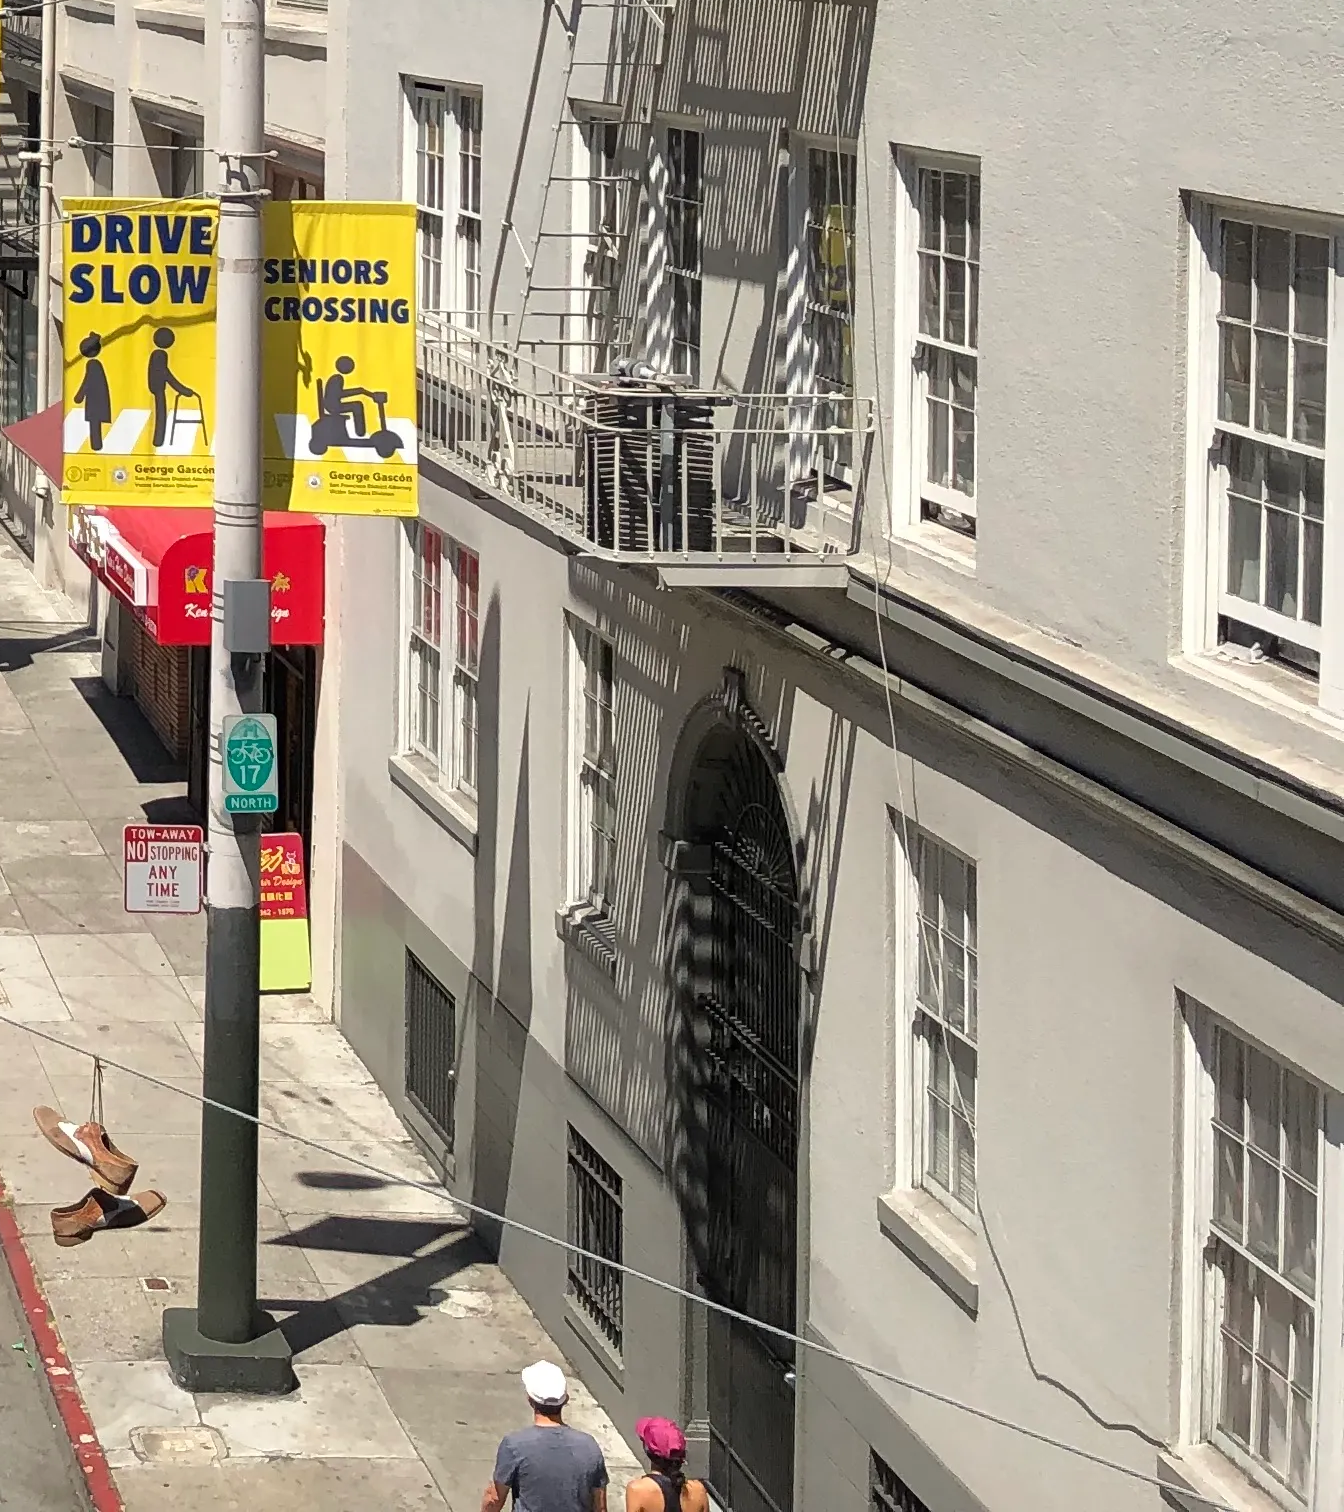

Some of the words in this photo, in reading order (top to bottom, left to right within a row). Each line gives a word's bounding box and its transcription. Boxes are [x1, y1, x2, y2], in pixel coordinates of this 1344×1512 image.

[70, 214, 214, 254] DRIVE
[263, 258, 390, 286] SENIORS
[68, 263, 210, 305] SLOW
[264, 295, 410, 324] CROSSING
[135, 464, 174, 476] George
[176, 463, 215, 474] Gascón
[329, 471, 370, 483] George
[373, 472, 413, 482] Gascón
[239, 764, 261, 785] 17
[230, 797, 272, 809] NORTH
[130, 828, 194, 840] TOW-AWAY
[127, 841, 146, 861] NO
[150, 846, 198, 861] STOPPING
[148, 865, 177, 880] ANY
[146, 883, 180, 897] TIME
